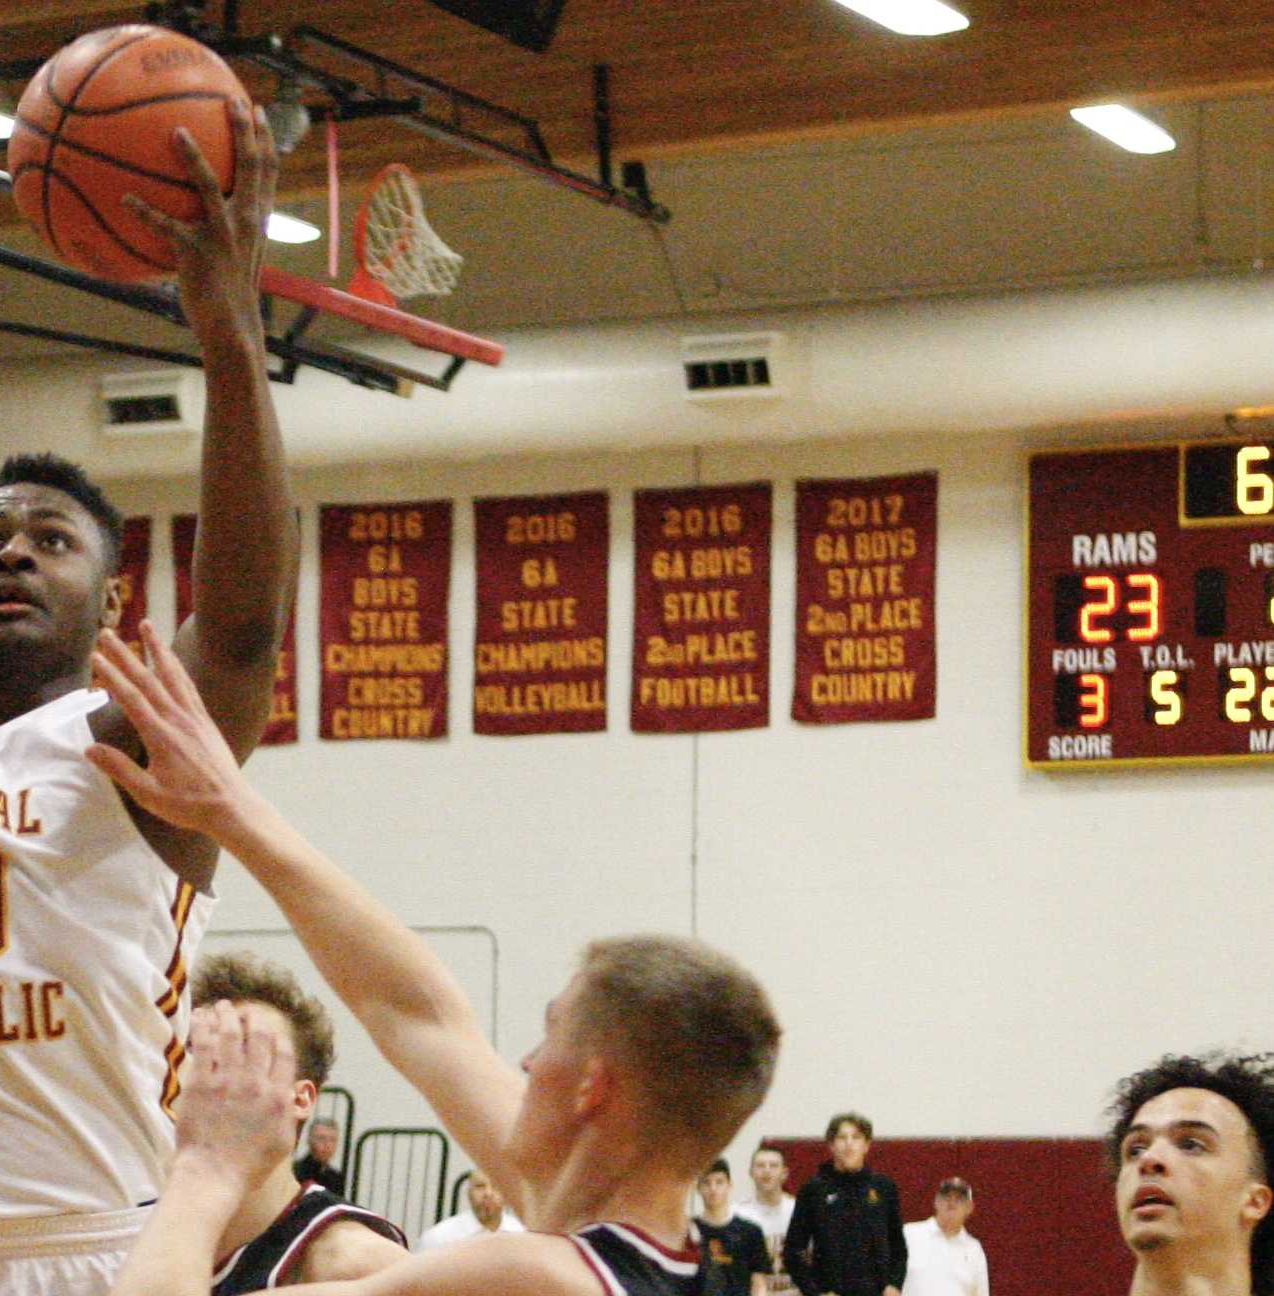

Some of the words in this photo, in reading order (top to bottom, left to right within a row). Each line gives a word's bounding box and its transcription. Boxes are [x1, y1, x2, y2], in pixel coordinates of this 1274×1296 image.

[348, 511, 424, 542] 2016
[505, 511, 577, 546] 2016
[663, 504, 743, 538] 2016
[827, 495, 905, 528] 2017
[367, 544, 403, 574] 6A
[651, 550, 687, 581] 6A
[690, 545, 754, 578] BOYS
[814, 533, 850, 564] 6A
[854, 527, 918, 562] BOYS
[1072, 531, 1158, 567] RAMS
[521, 558, 560, 589] 6A
[827, 564, 905, 600] STATE
[353, 577, 419, 607] BOYS
[663, 588, 741, 623] STATE
[1080, 574, 1160, 642] 23
[349, 610, 421, 641] STATE
[501, 597, 577, 632] STATE
[849, 597, 923, 632] PLACE
[327, 643, 444, 673] CHAMPIONS
[476, 636, 605, 673] CHAMPIONS
[686, 630, 758, 665] PLACE
[825, 634, 906, 669] CROSS
[1052, 648, 1117, 673] FOULS
[347, 676, 424, 707] CROSS
[475, 680, 605, 716] VOLLEYBALL
[639, 673, 760, 711] FOOTBALL
[810, 670, 918, 705] COUNTRY
[1080, 673, 1107, 729] 3
[1151, 670, 1181, 725] 5
[333, 706, 437, 738] COUNTRY
[1048, 735, 1113, 760] SCORE
